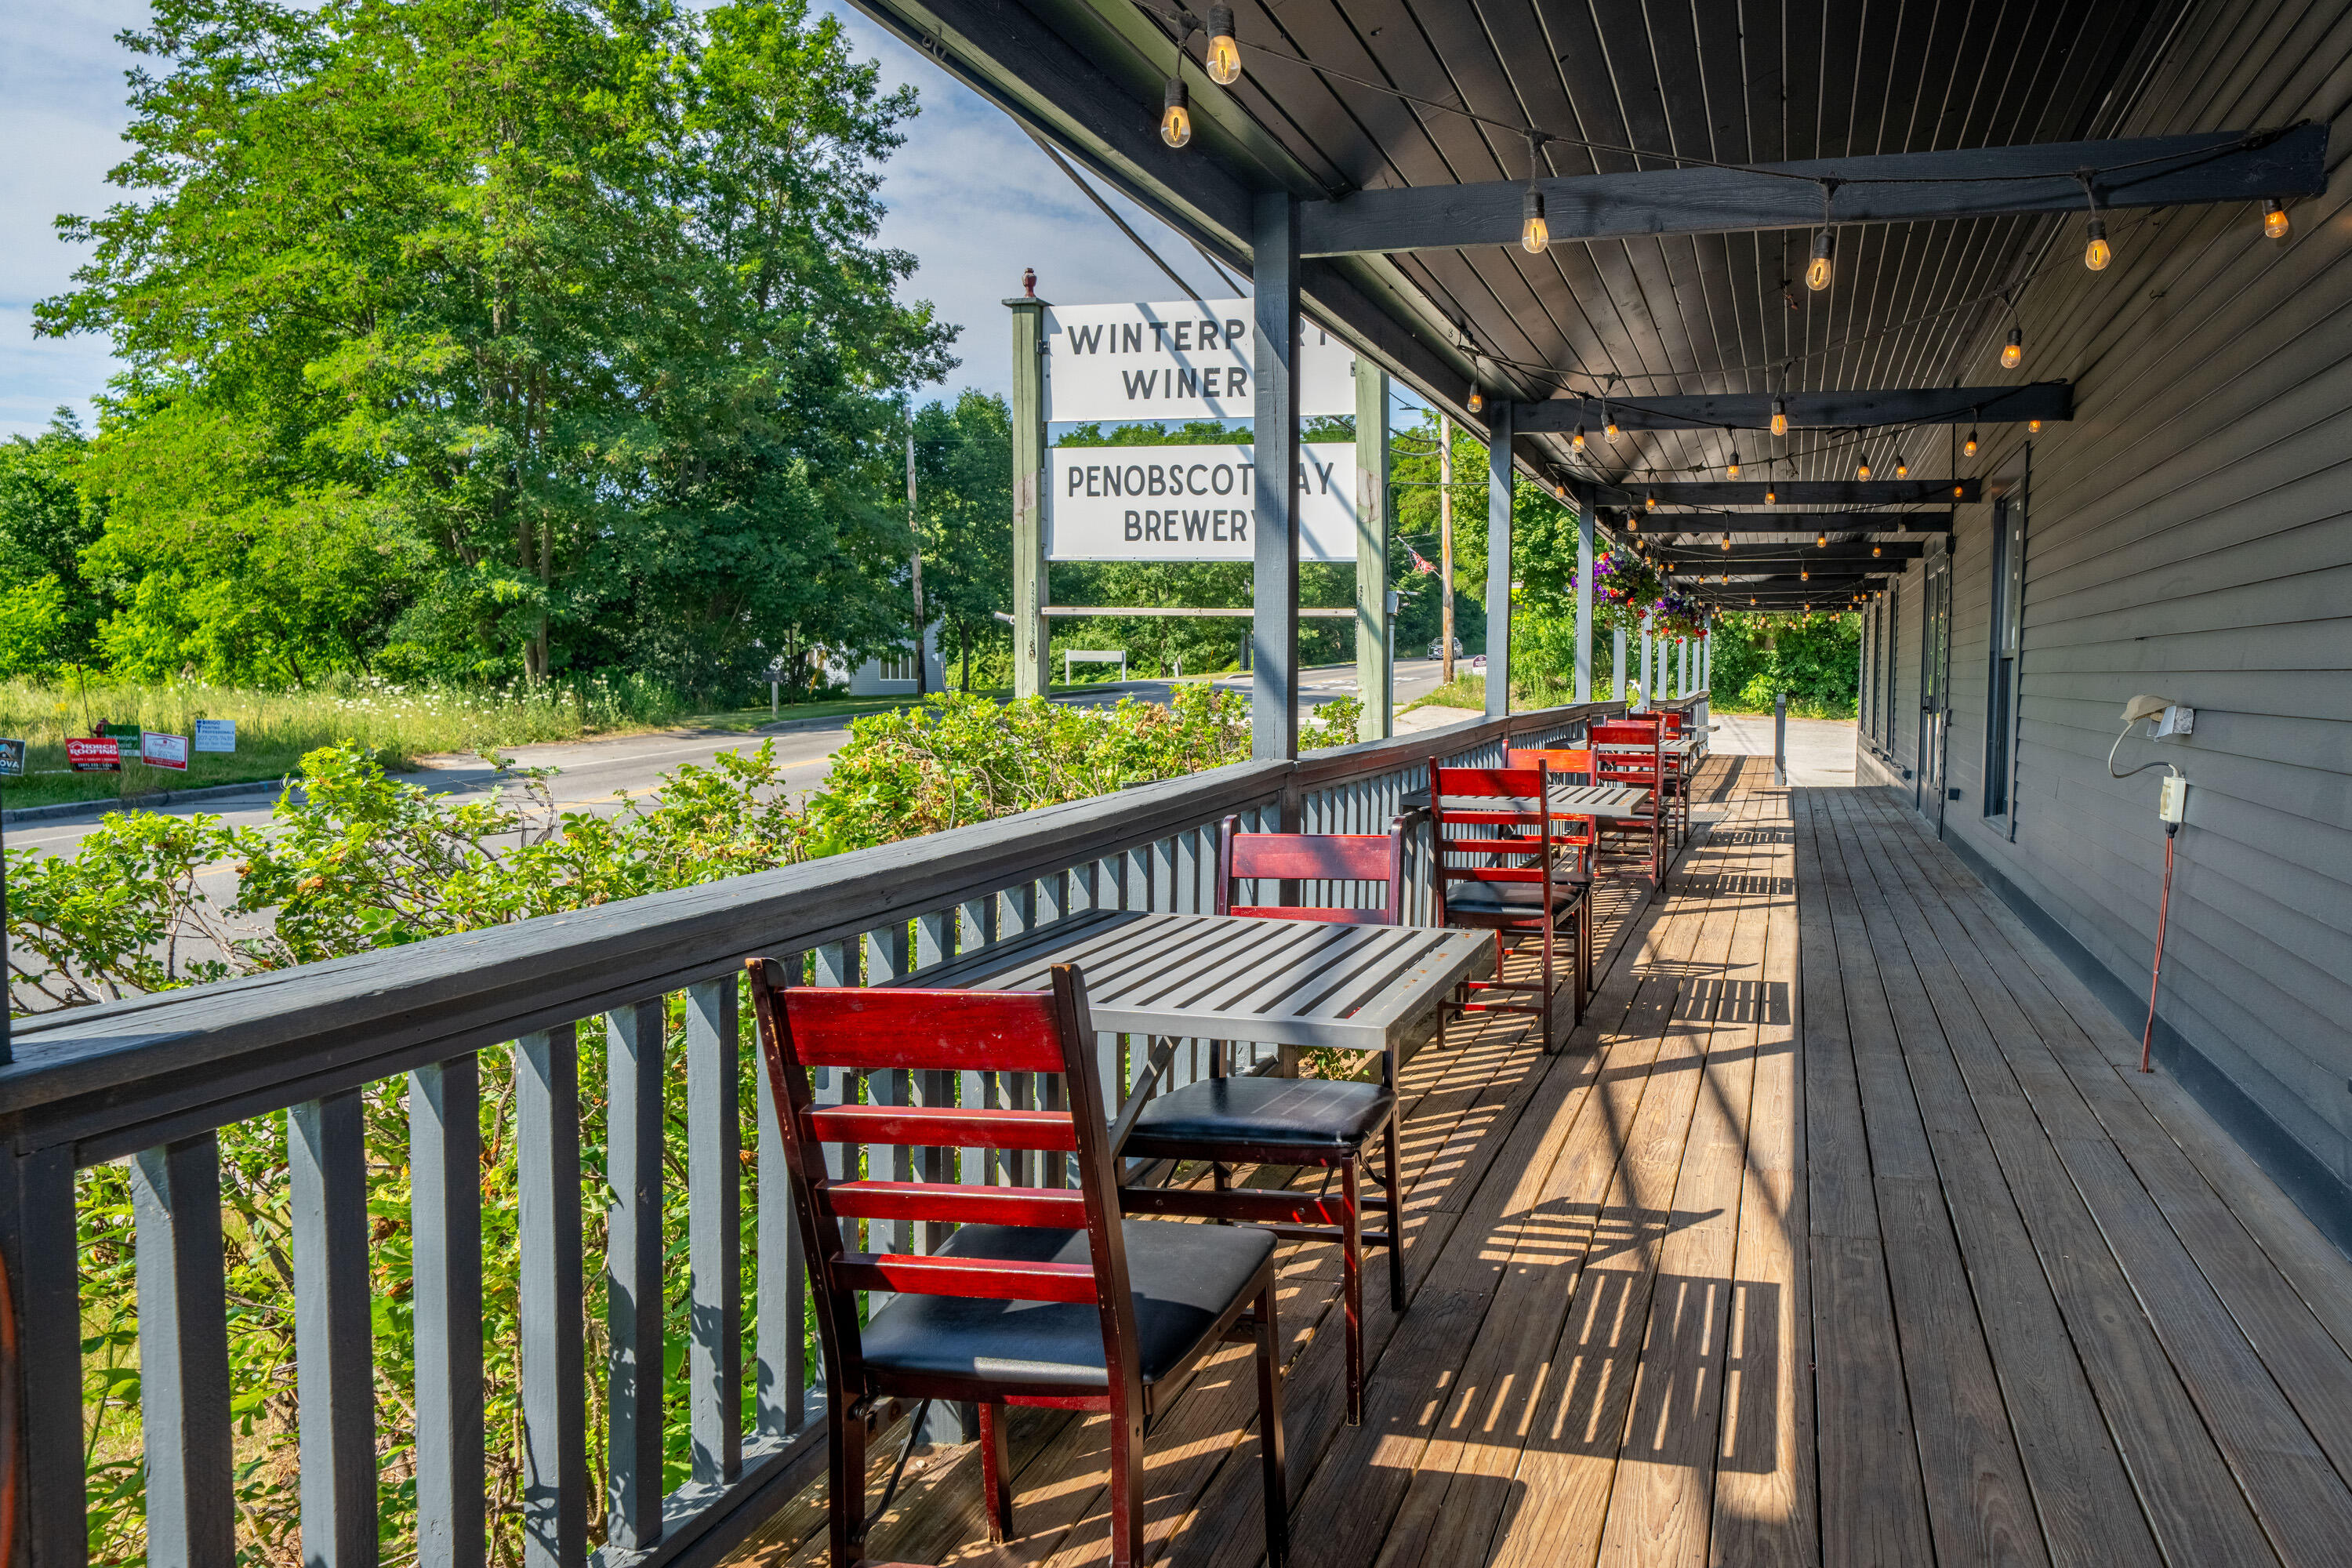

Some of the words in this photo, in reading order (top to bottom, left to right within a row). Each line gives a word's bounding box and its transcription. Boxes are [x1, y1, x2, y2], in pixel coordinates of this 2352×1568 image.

[1067, 318, 1327, 355] WINTERP
[1122, 366, 1248, 401] WINER
[1069, 463, 1254, 497] PENOBSCOT
[1299, 462, 1334, 495] AY
[1124, 509, 1254, 542] BREWER
[0, 759, 20, 768] OVA
